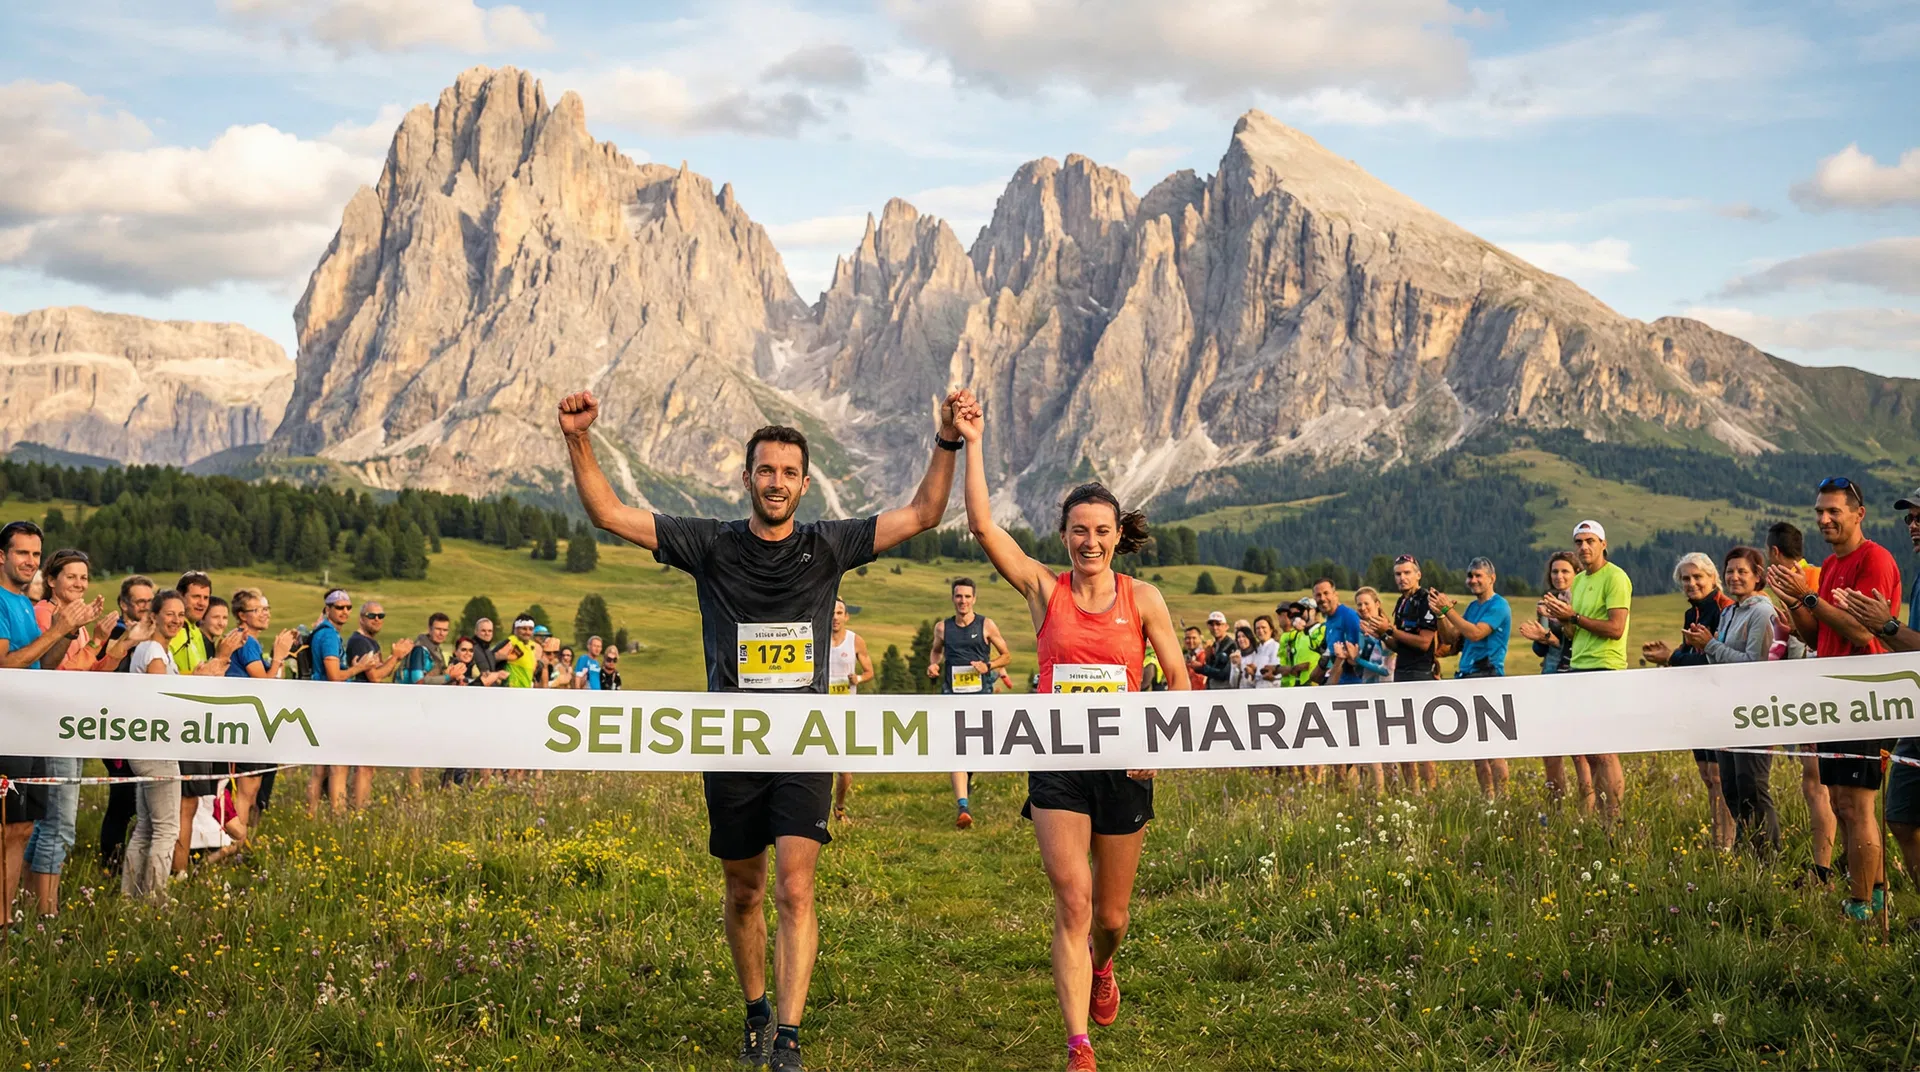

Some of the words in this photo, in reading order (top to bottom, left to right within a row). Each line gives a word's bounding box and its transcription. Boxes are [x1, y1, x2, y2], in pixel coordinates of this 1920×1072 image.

[758, 644, 796, 664] 173
[1849, 690, 1915, 723] alm
[180, 712, 249, 745] alm
[544, 705, 771, 756] SEISER
[792, 709, 929, 756] ALM
[954, 707, 1121, 756] HALF
[1145, 693, 1518, 752] MARATHON
